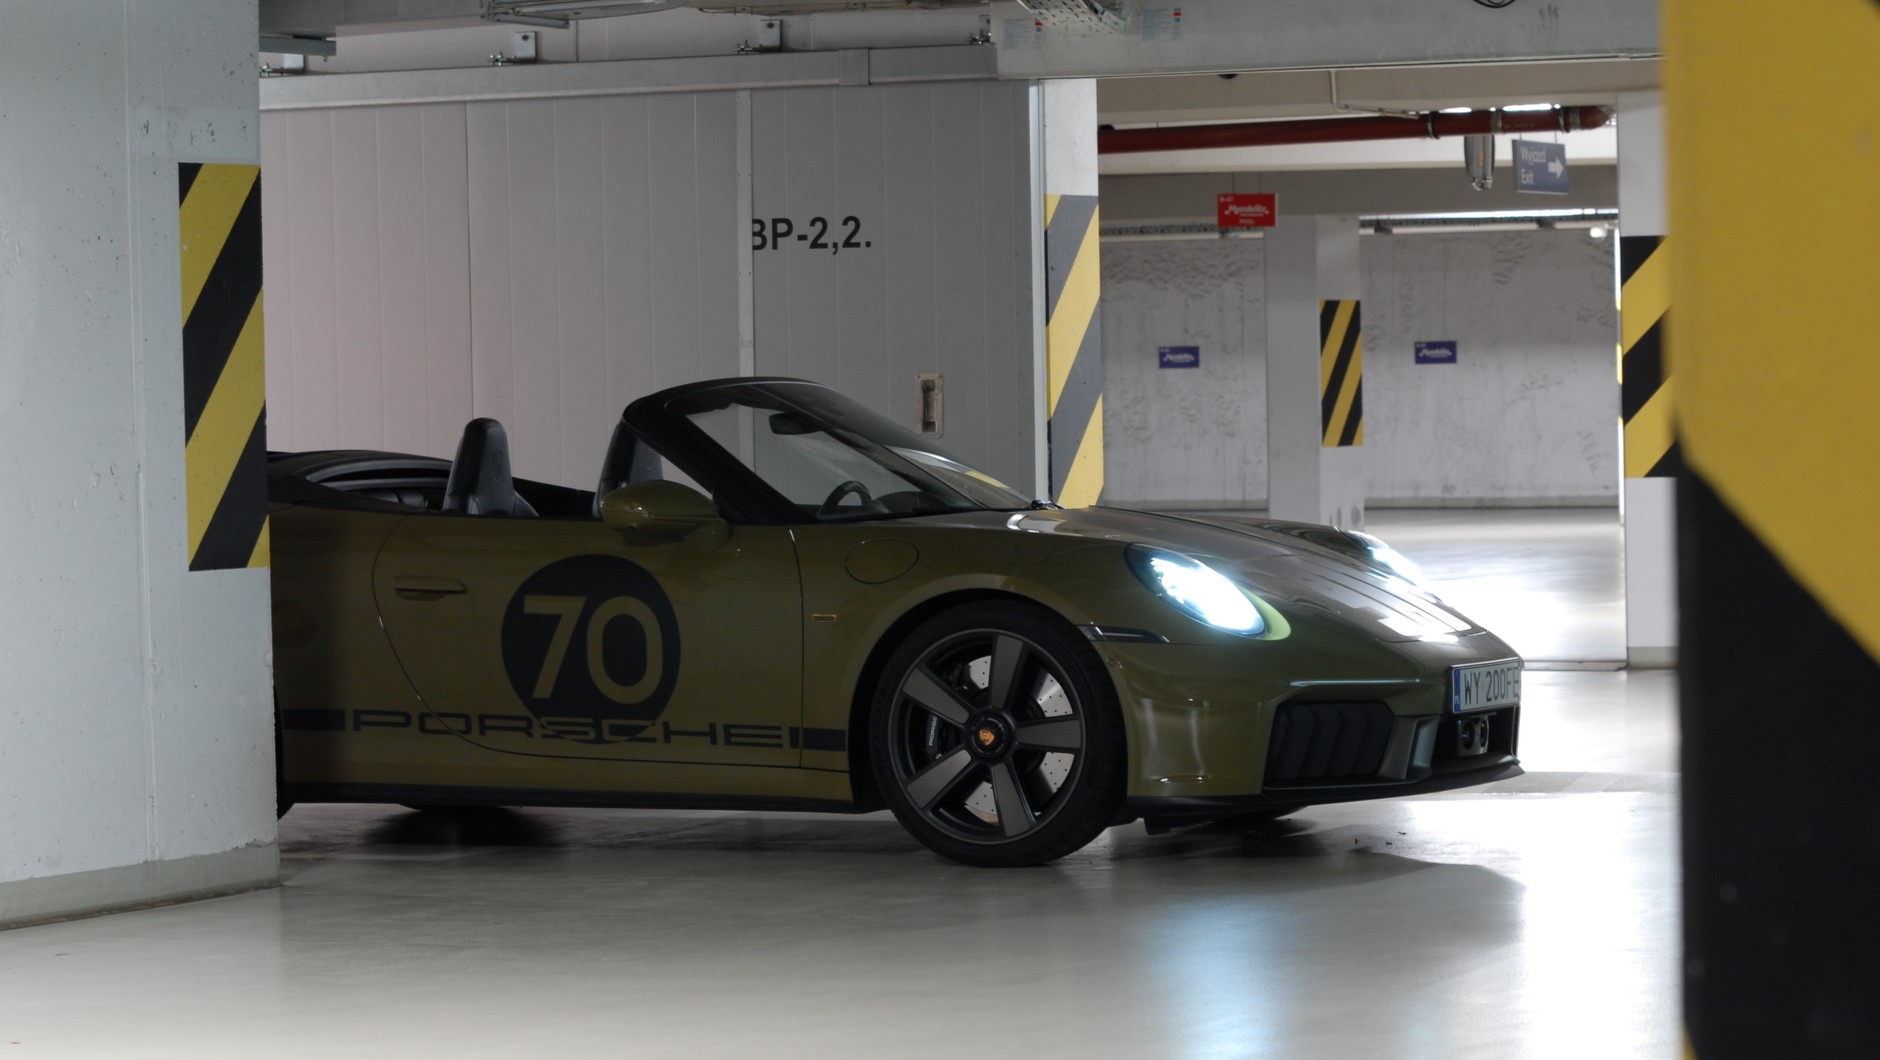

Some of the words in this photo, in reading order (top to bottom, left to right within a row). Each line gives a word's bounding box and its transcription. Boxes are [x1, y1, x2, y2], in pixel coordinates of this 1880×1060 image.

[1521, 168, 1534, 185] Exit
[524, 594, 663, 704] 70
[1464, 672, 1481, 705] WY
[353, 710, 783, 748] PORSCHE
